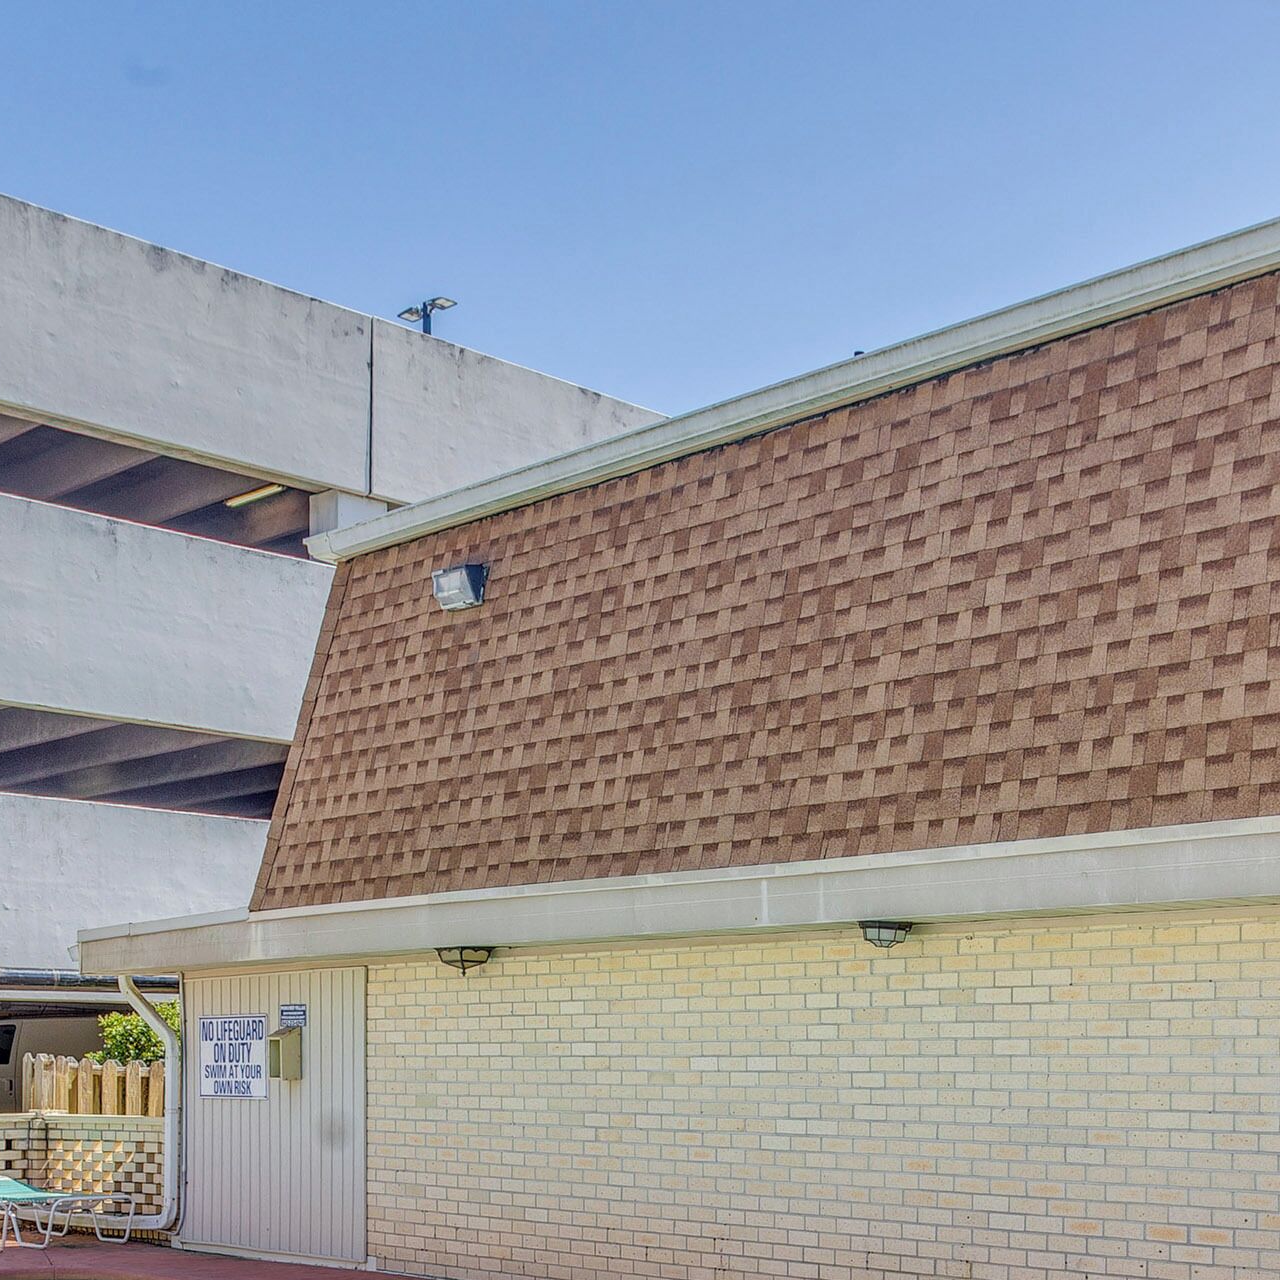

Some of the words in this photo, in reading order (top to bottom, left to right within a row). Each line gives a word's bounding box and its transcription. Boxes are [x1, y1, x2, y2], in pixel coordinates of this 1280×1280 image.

[201, 1021, 214, 1042] NO
[216, 1020, 264, 1041] LIFEGUARD
[213, 1043, 226, 1063] ON
[228, 1042, 252, 1063] DUTY
[204, 1064, 227, 1079] SWIM
[228, 1065, 239, 1079] AT
[240, 1064, 262, 1079] YOUR
[213, 1080, 233, 1094] OWN
[234, 1080, 252, 1095] RISK
